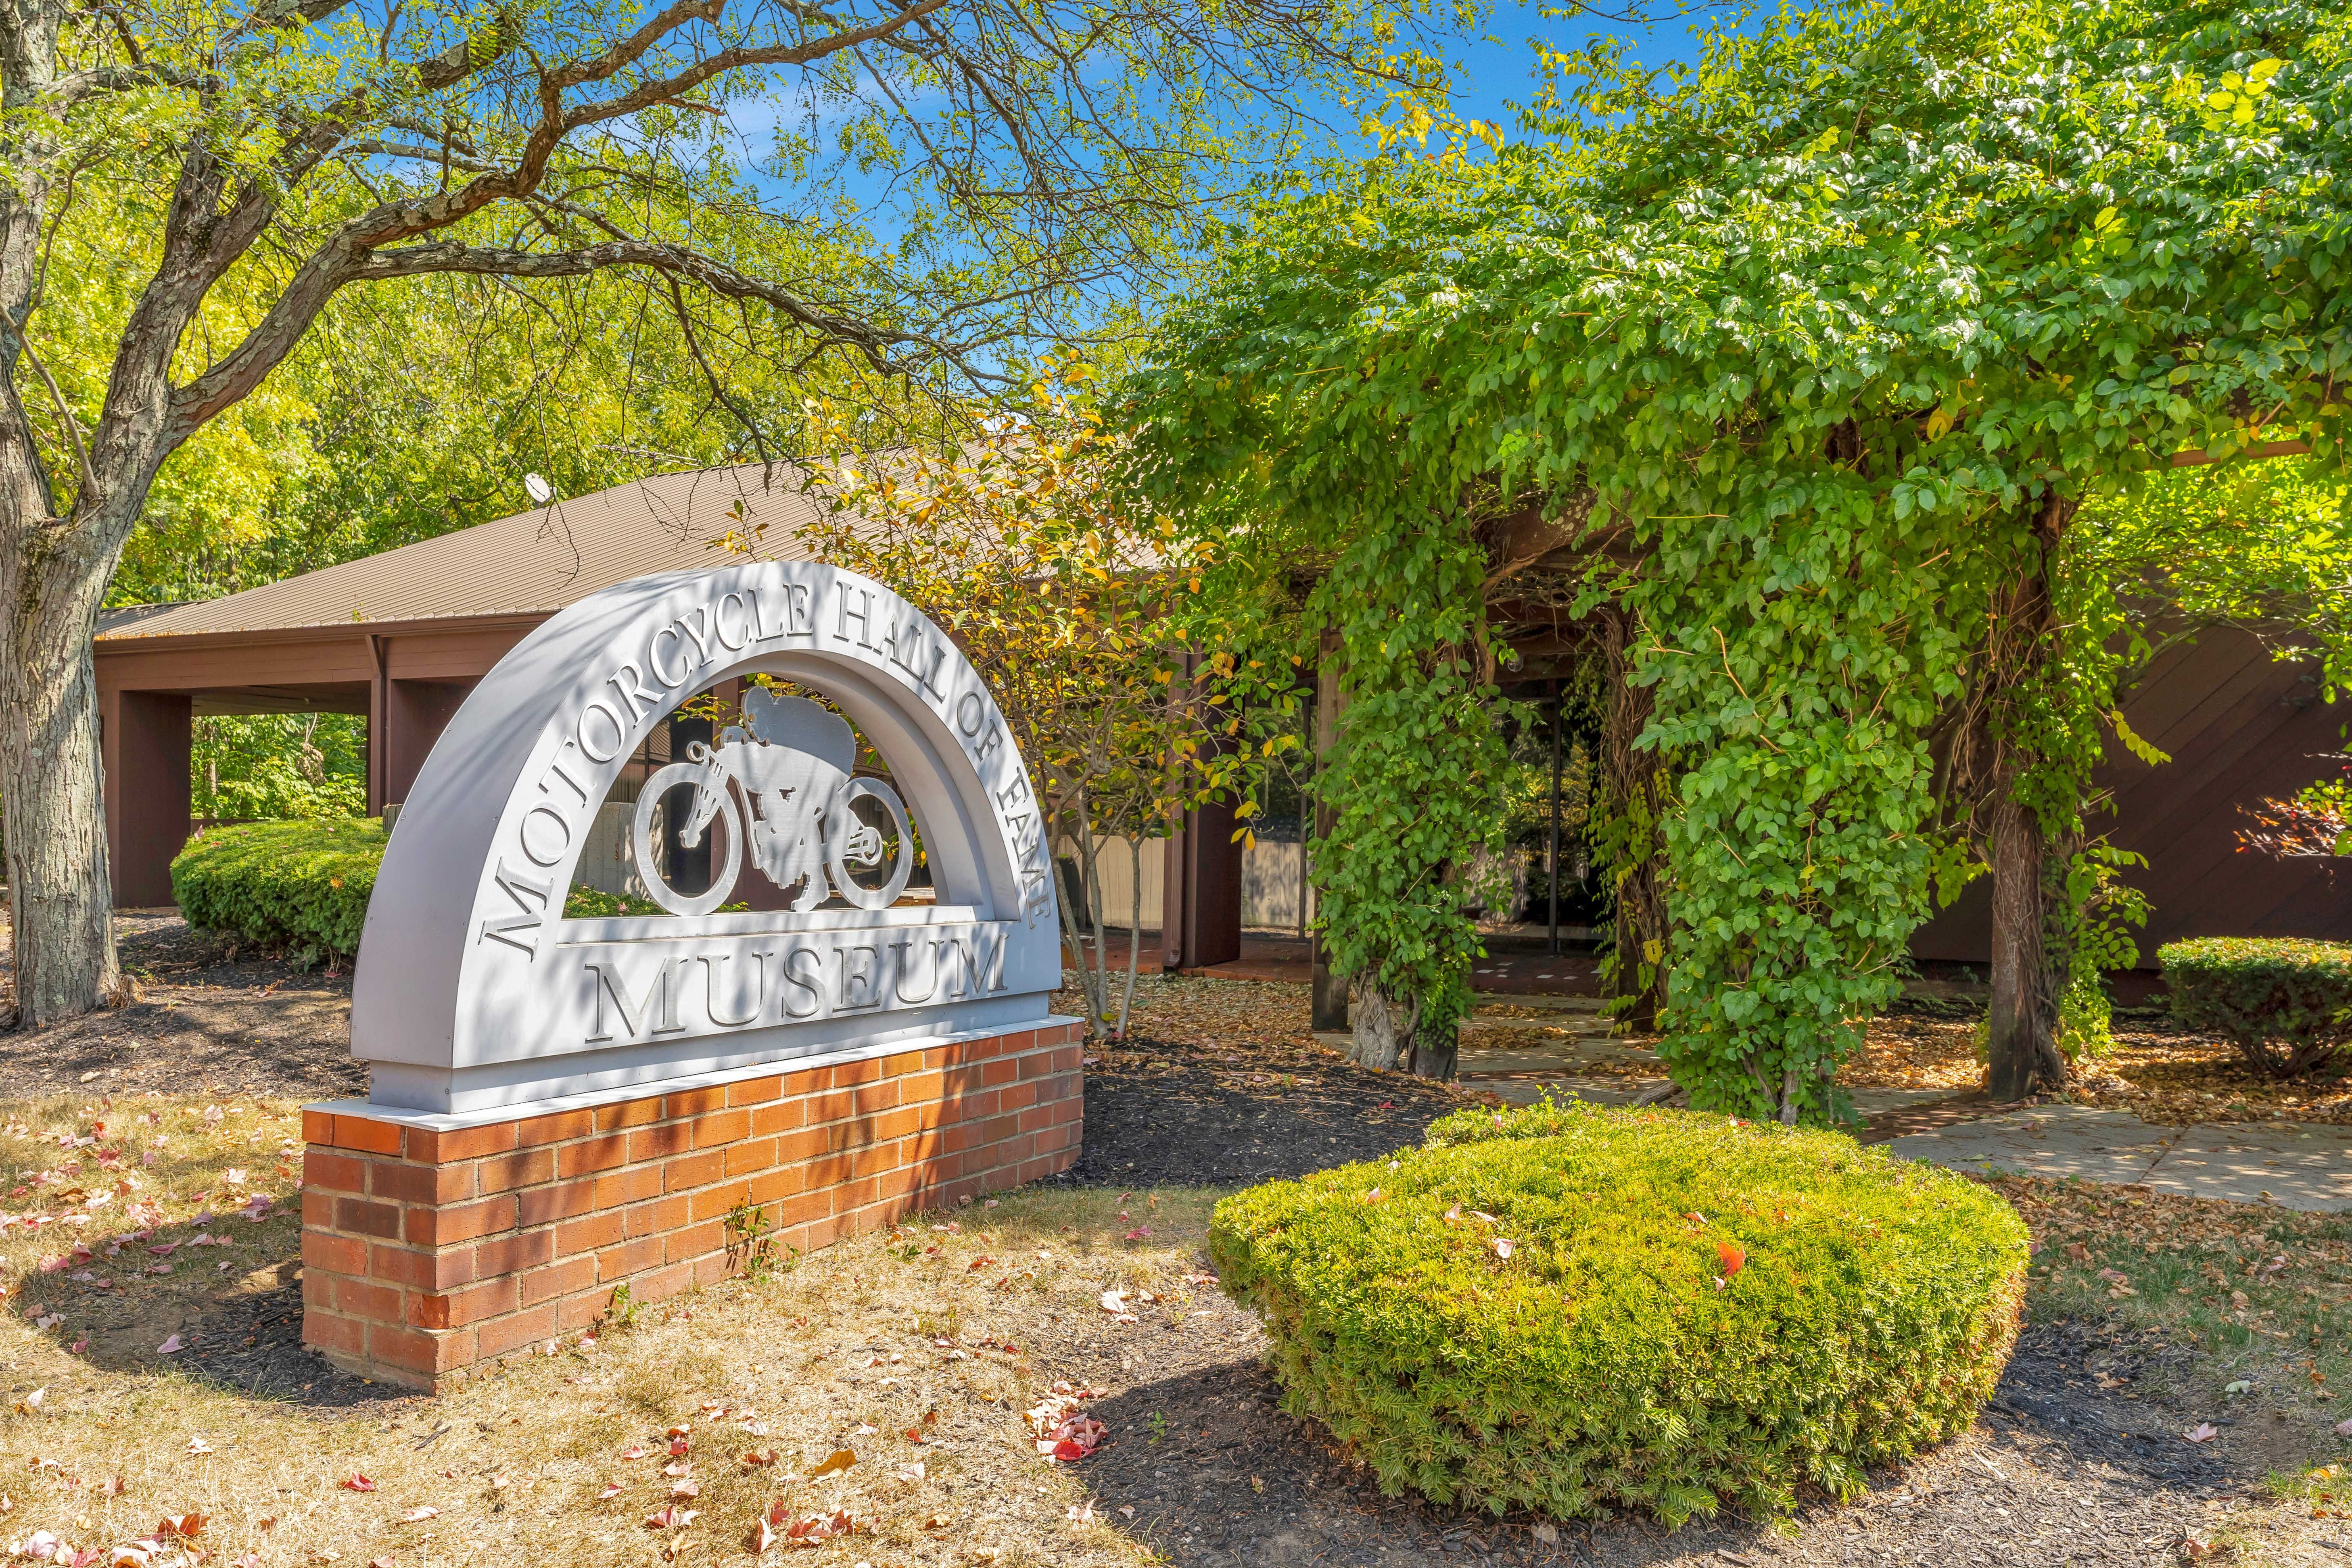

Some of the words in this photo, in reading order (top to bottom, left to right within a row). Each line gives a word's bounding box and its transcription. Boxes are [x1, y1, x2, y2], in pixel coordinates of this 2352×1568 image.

[479, 583, 813, 963] MOTORCYCLE
[833, 581, 946, 703] HALL
[957, 691, 1003, 761] OF
[997, 766, 1050, 928] FAME
[585, 934, 1009, 1042] MUSEUM
